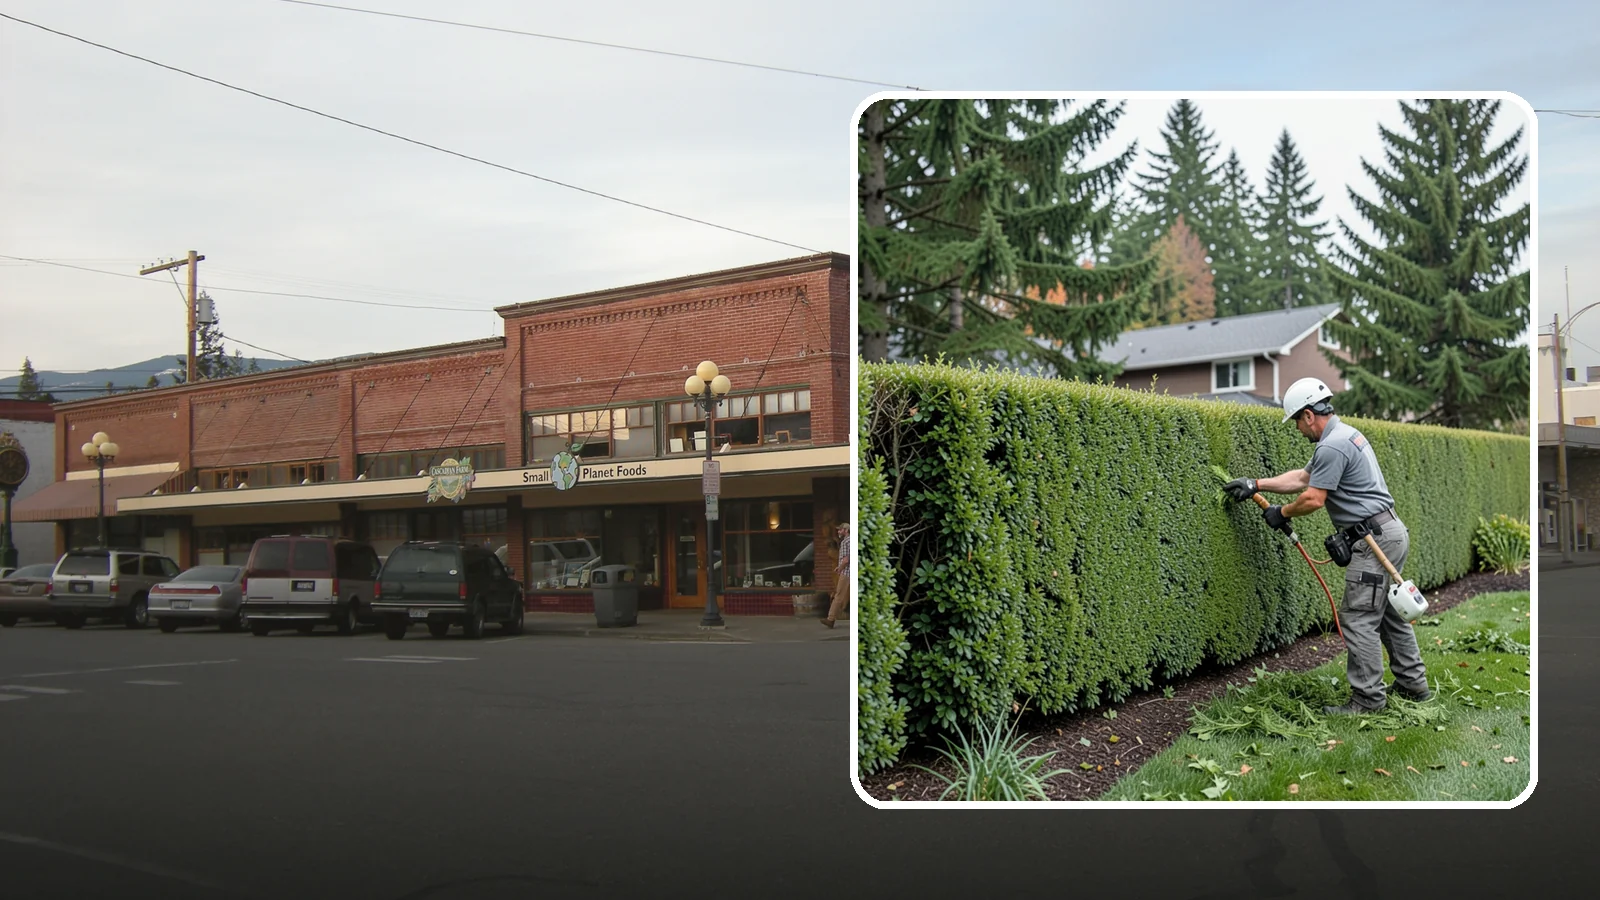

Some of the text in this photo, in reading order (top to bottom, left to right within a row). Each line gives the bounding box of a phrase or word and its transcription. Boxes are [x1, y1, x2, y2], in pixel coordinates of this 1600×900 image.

[523, 464, 647, 483] Small Planet Foods
